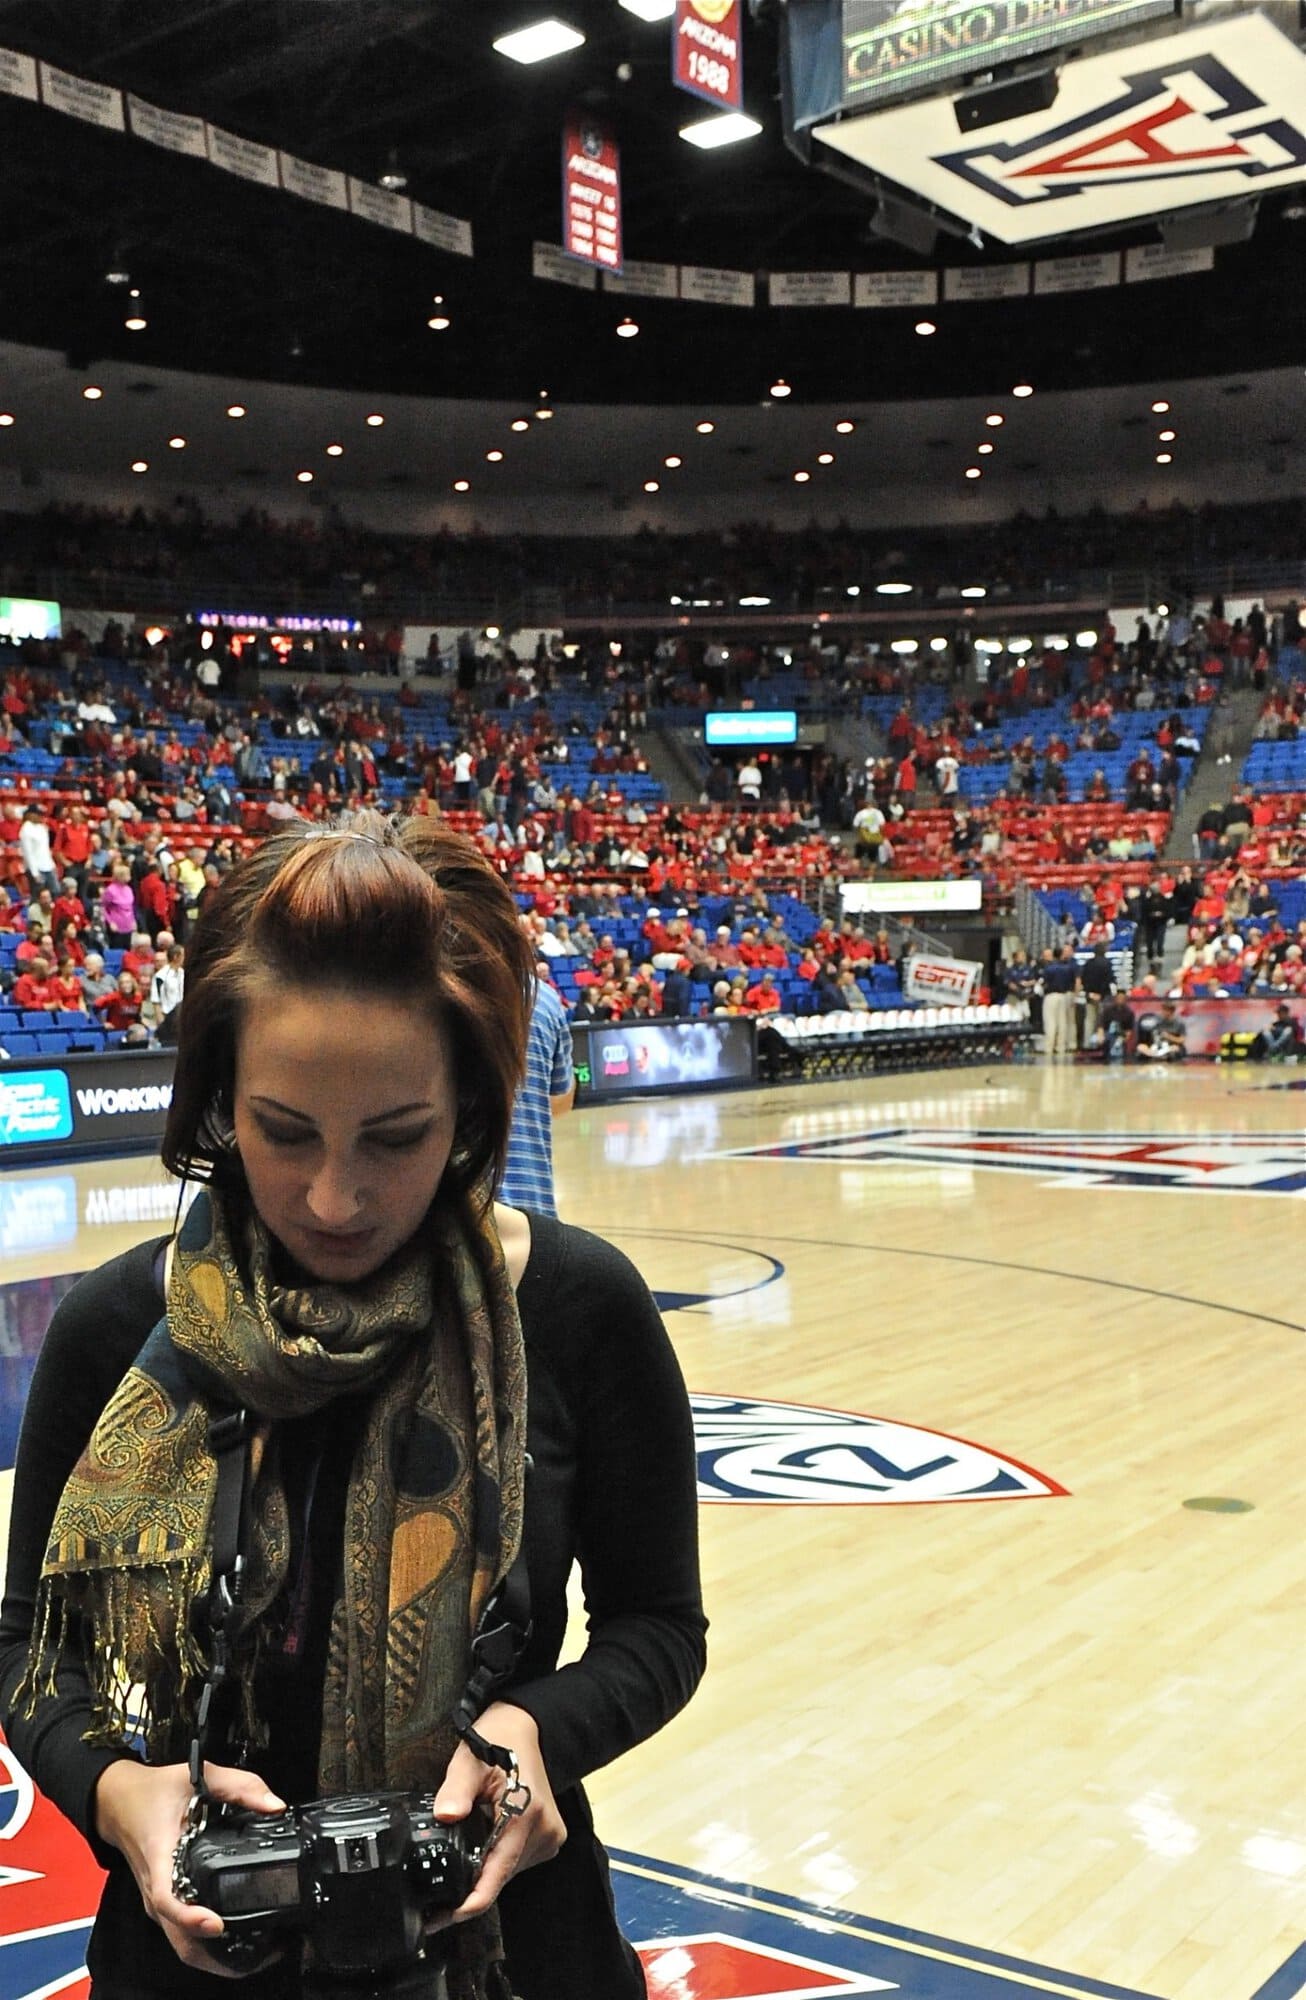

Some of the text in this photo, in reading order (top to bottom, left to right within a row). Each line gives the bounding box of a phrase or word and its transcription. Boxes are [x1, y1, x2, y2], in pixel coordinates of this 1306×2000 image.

[679, 16, 737, 61] ARIZONA
[847, 7, 996, 79] CASINO
[688, 51, 730, 94] 1988
[914, 963, 968, 988] ESPN
[76, 1083, 173, 1116] WORKIN
